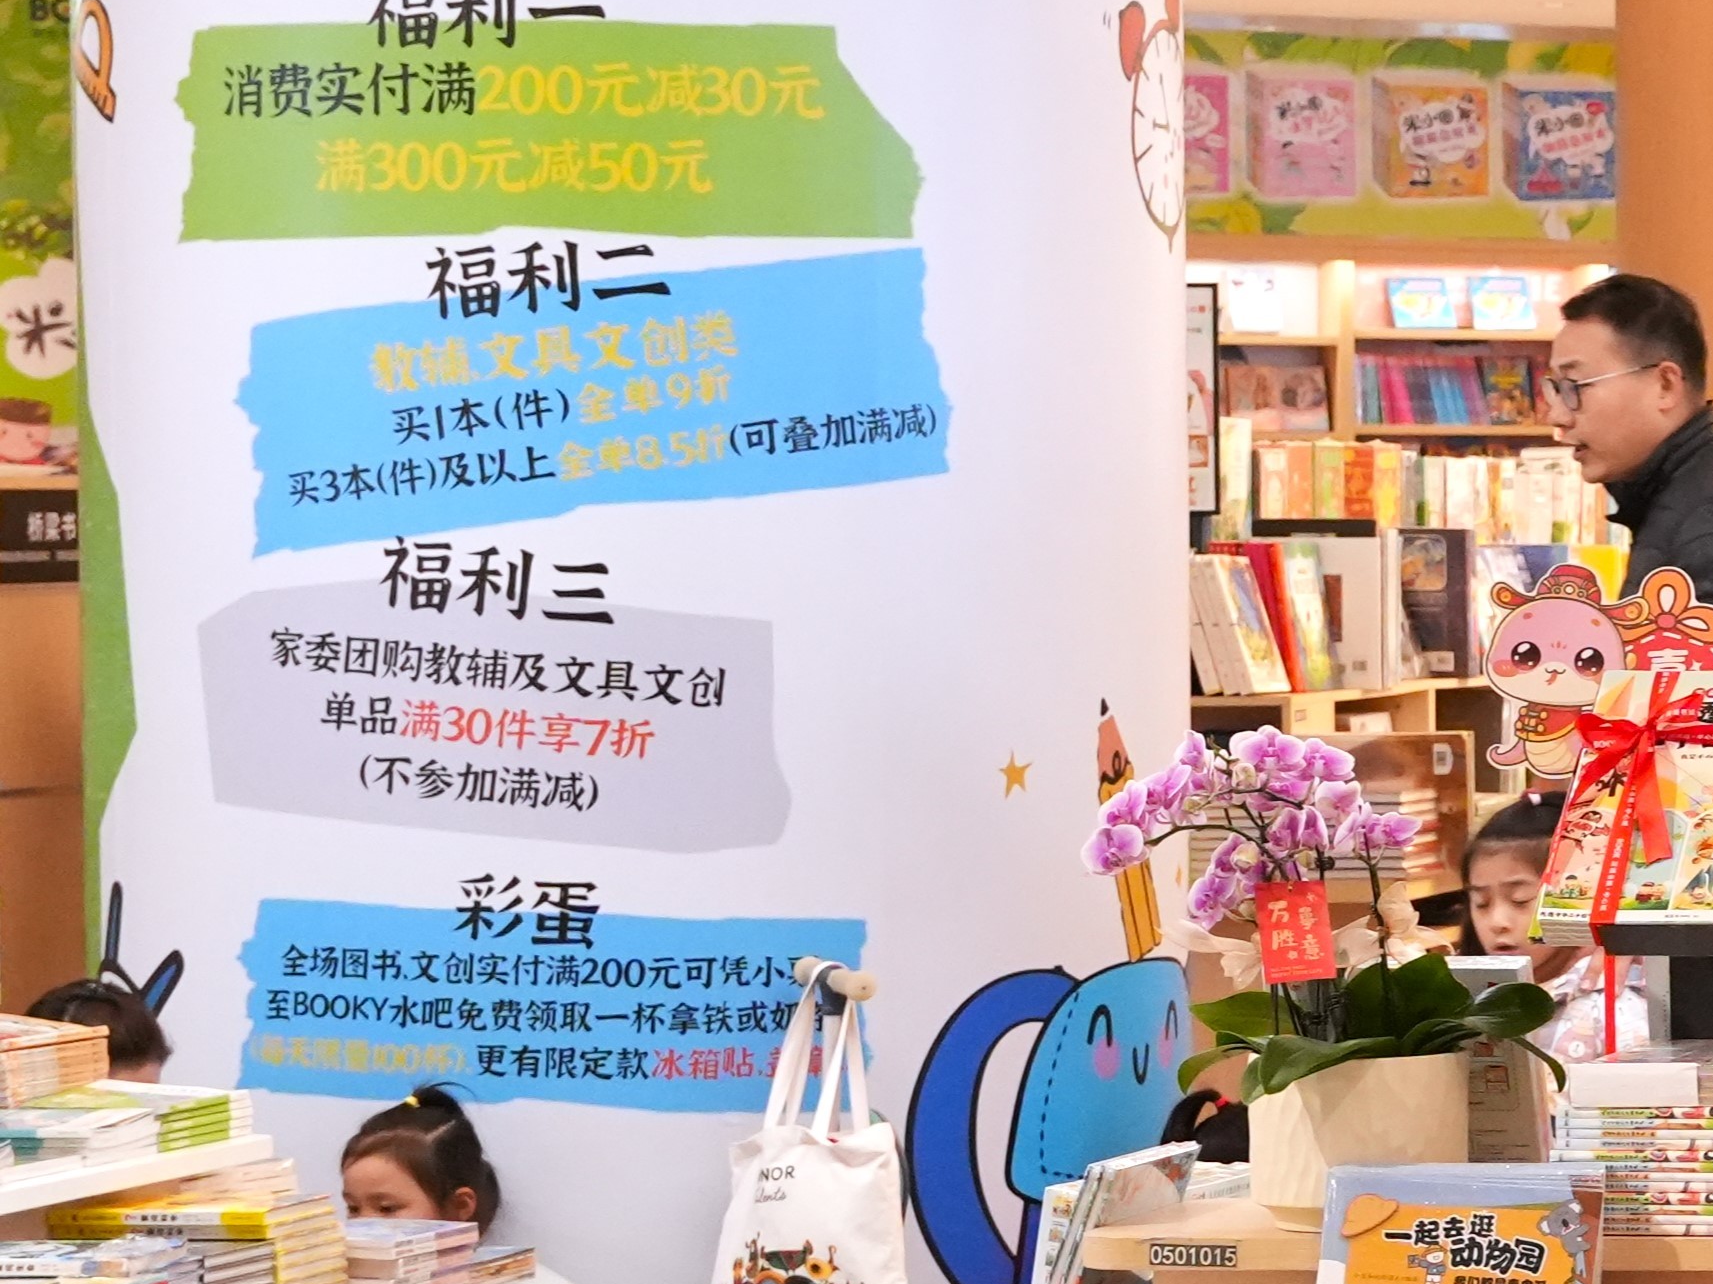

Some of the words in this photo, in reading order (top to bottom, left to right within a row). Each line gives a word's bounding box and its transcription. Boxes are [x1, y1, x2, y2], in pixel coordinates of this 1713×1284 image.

[316, 138, 713, 193] 满300元减50元
[426, 242, 672, 319] 福利二
[380, 535, 614, 626] 福利三
[269, 628, 727, 708] 家委团购教辅及文具文创
[357, 755, 600, 813] (不参加满减)
[456, 873, 601, 951] 彩蛋
[1149, 1244, 1237, 1268] 0501015
[1383, 1212, 1495, 1249] 一起去逛
[1447, 1237, 1548, 1275] 动物园
